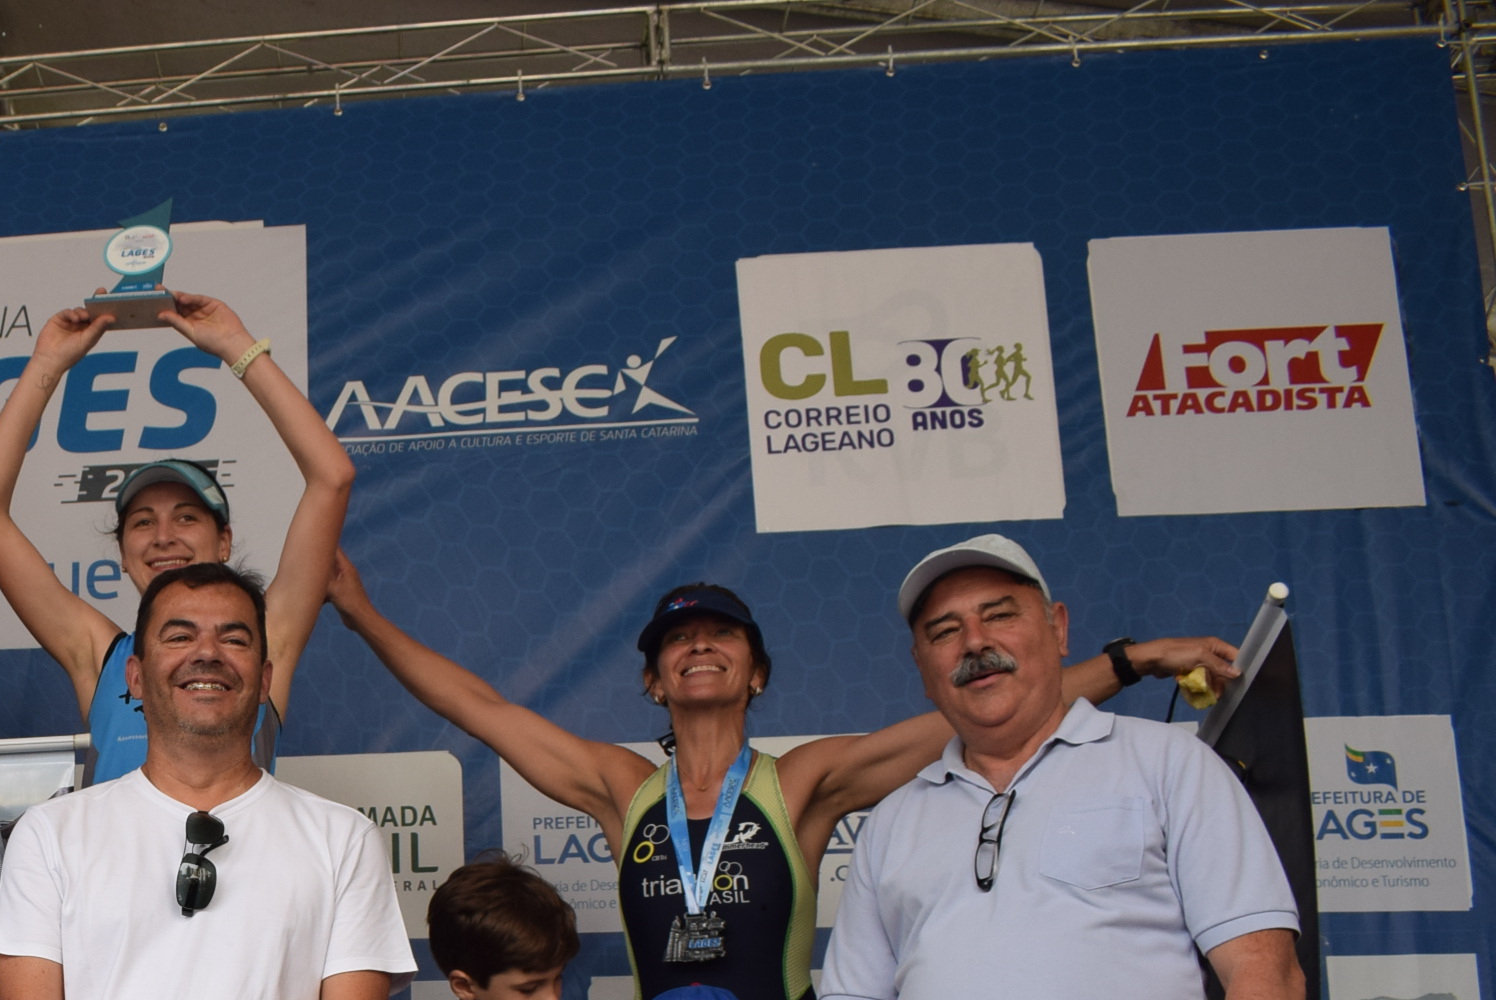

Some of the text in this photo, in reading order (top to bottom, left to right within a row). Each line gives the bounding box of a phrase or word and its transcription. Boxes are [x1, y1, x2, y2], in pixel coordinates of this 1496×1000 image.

[760, 331, 888, 400] CL
[1126, 386, 1372, 418] ATACADISTA
[764, 404, 985, 431] CORREIO ANOS
[389, 442, 405, 453] DE
[408, 439, 445, 451] APOIO
[460, 434, 512, 448] CULTURA
[515, 434, 522, 445] E
[526, 431, 577, 445] ESPORTE
[581, 430, 596, 442] DE
[600, 428, 637, 441] SANTA
[641, 425, 698, 439] CATARINA
[766, 428, 895, 454] LAGEANO
[1402, 790, 1426, 803] DE
[1332, 857, 1347, 869] de
[1351, 855, 1457, 869] Desenvolvimento
[572, 880, 587, 892] de
[1371, 878, 1379, 887] e
[1381, 875, 1430, 887] Turismo
